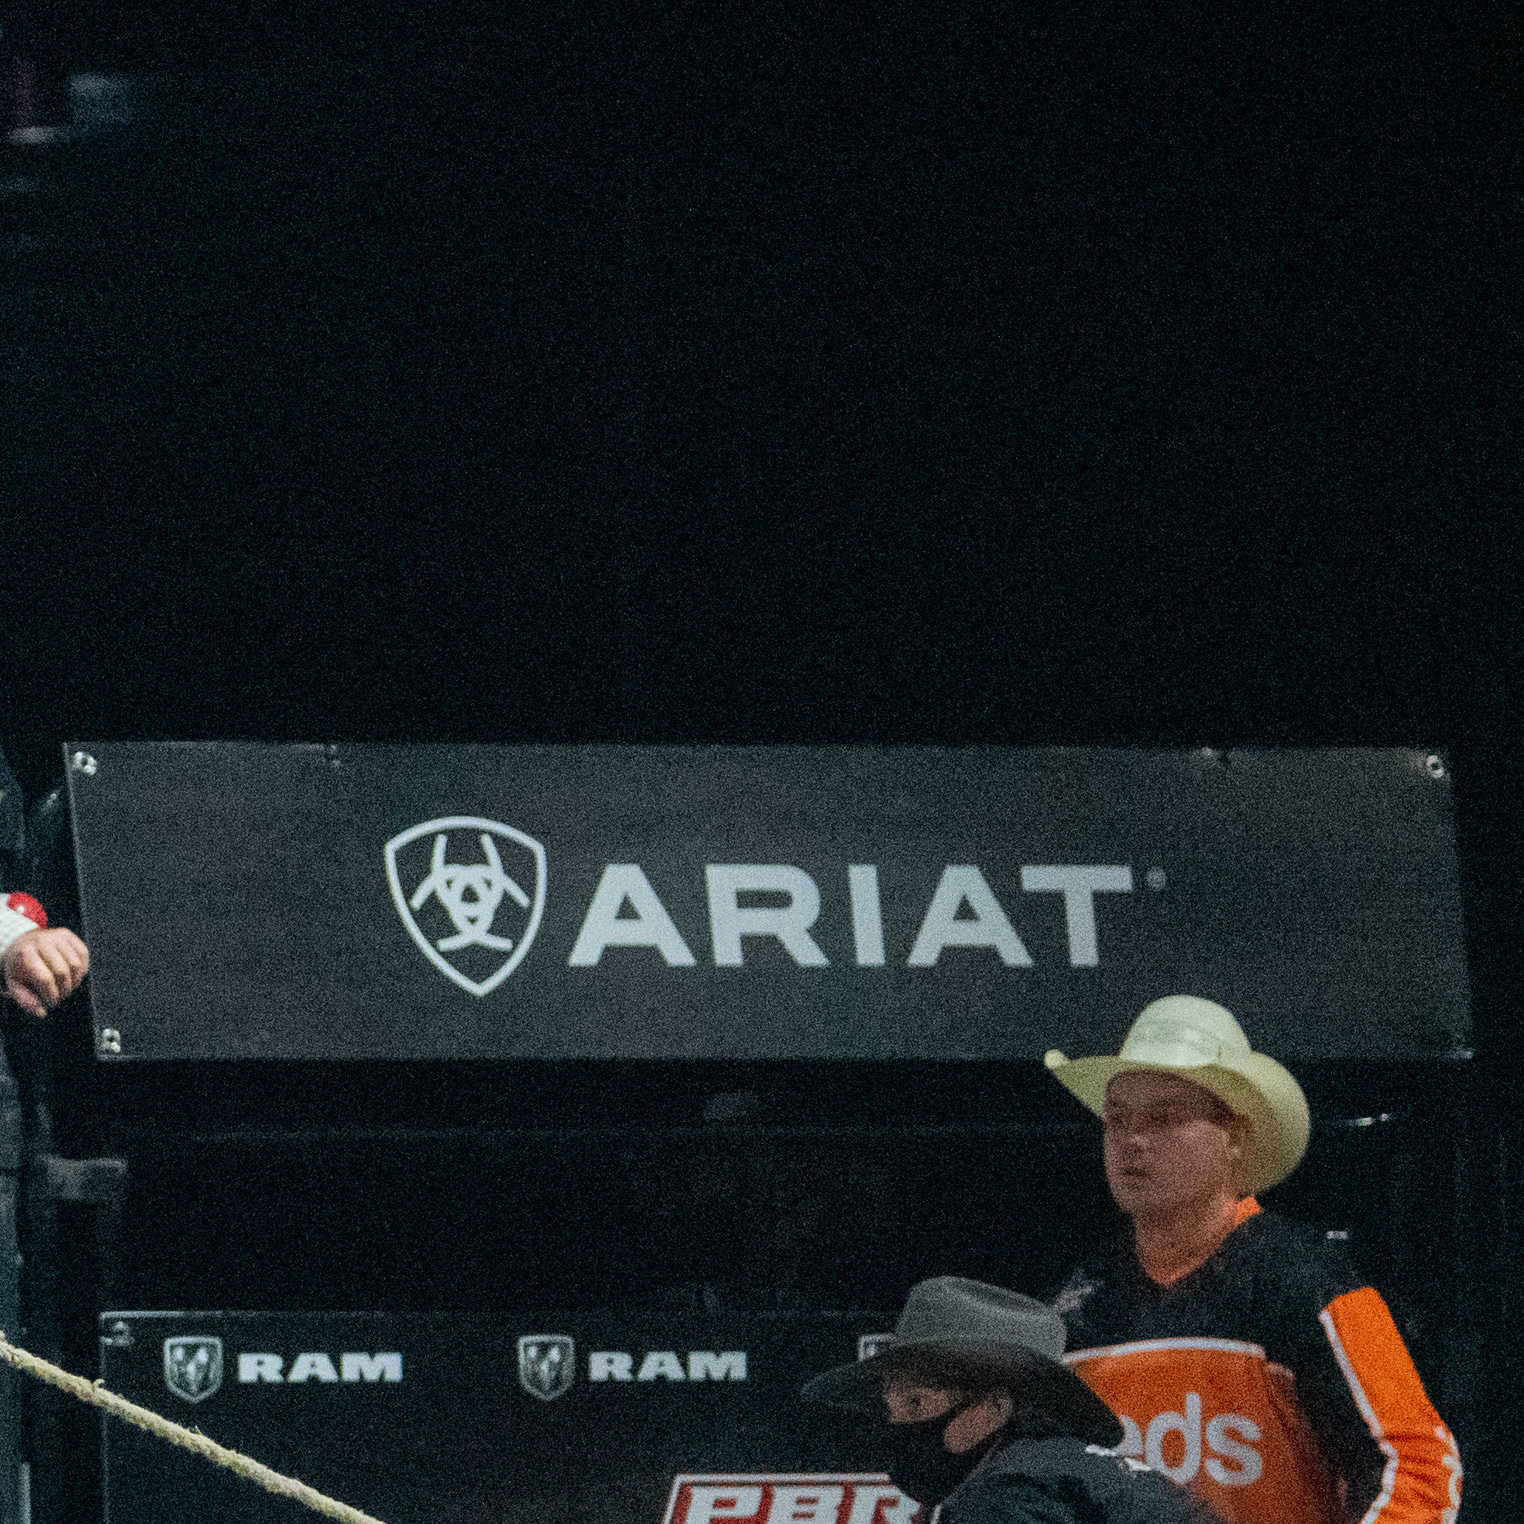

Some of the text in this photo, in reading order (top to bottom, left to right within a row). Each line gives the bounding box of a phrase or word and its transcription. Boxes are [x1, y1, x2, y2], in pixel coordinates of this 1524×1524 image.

[568, 863, 1133, 967] ARIAT
[238, 1350, 747, 1383] RAM RAM
[1112, 1392, 1262, 1485] ds
